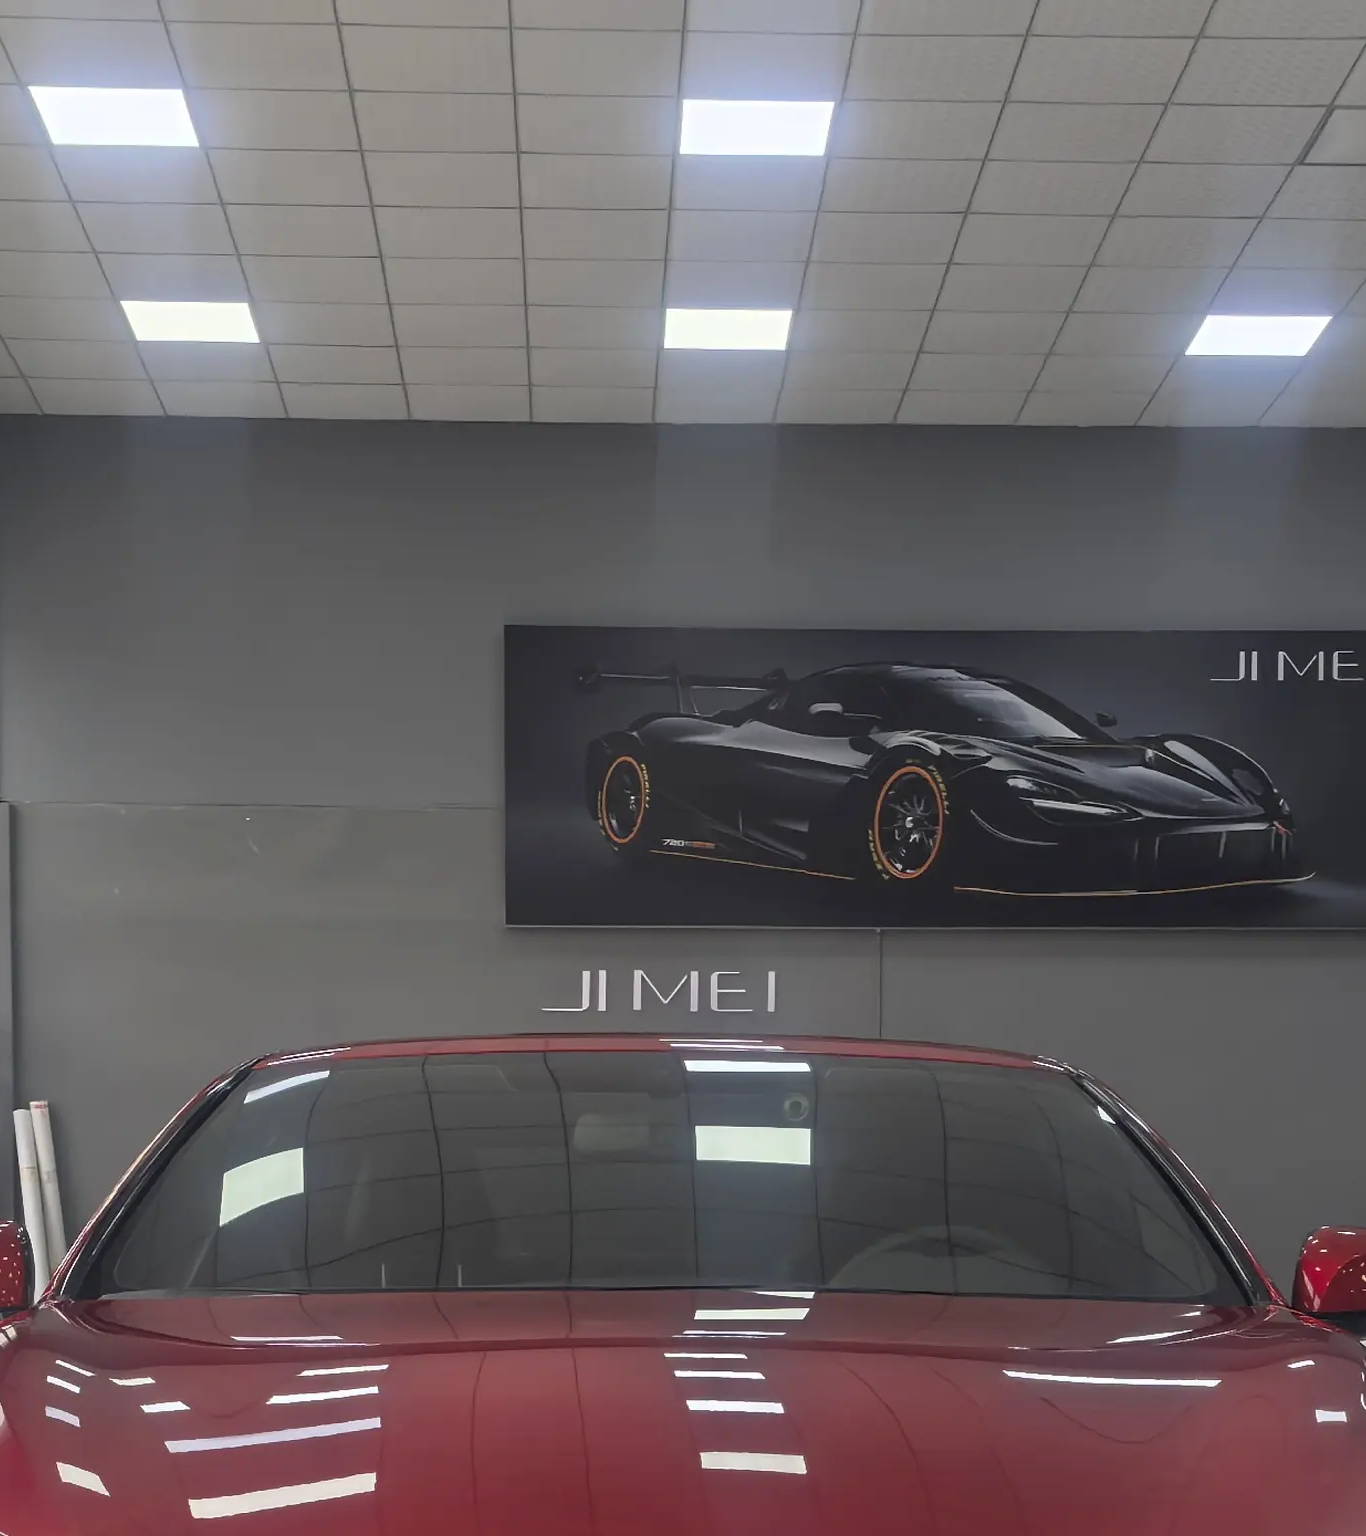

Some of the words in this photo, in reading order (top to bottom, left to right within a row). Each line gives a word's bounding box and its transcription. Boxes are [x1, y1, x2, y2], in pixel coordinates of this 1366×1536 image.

[1209, 650, 1258, 682] JI
[540, 969, 607, 1012] JI
[632, 969, 776, 1013] MEI
